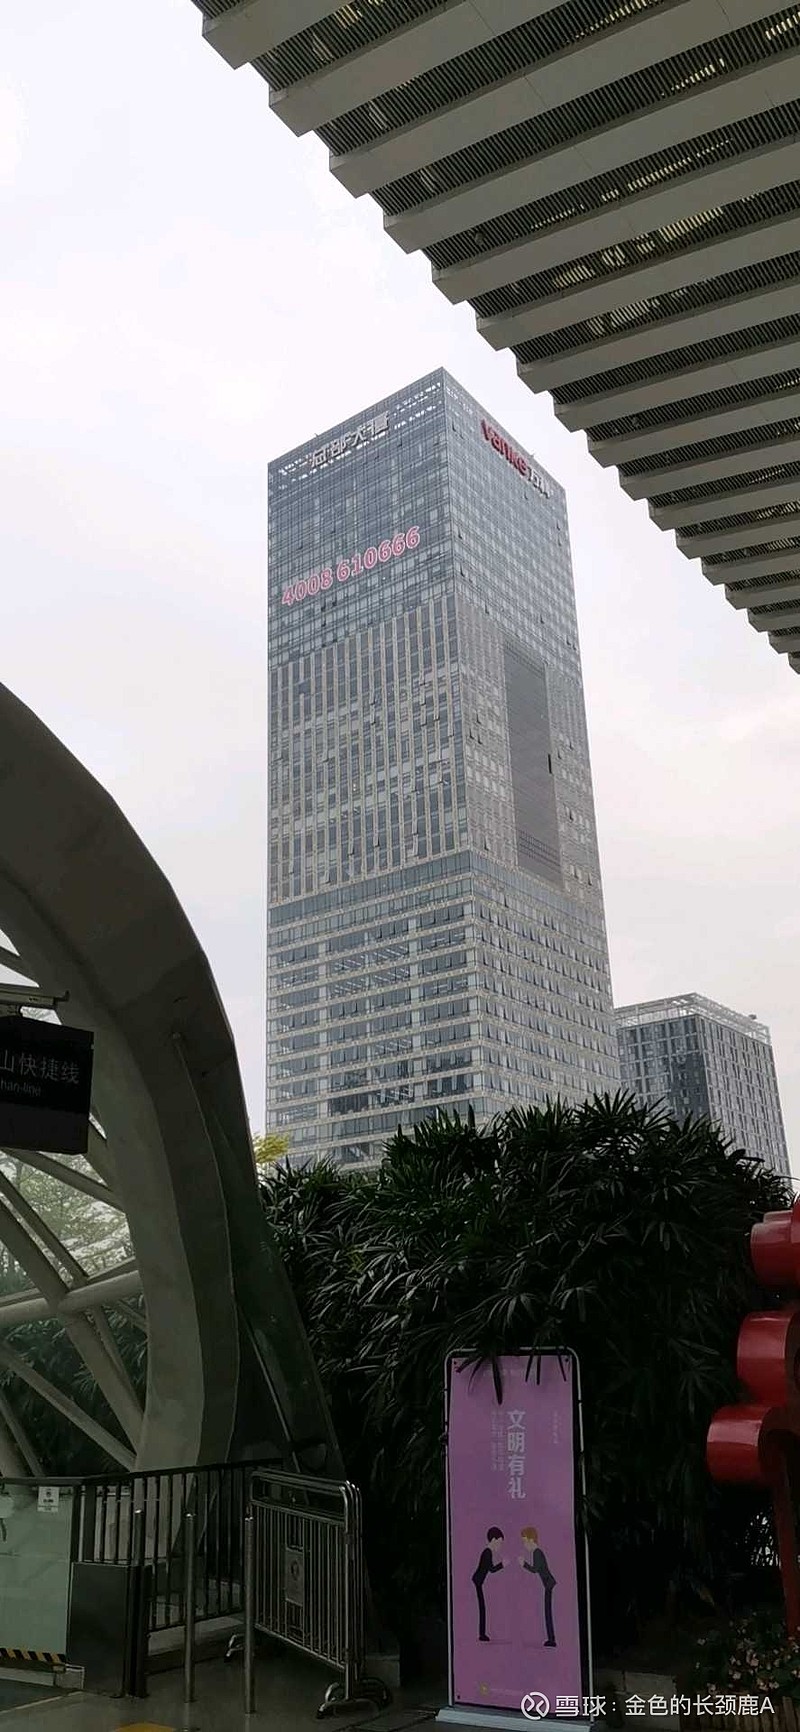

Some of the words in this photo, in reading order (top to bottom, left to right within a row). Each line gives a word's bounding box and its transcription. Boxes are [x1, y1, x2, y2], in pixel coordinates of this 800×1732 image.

[281, 567, 333, 606] 4008
[336, 525, 421, 582] 610666
[507, 1409, 526, 1499] 文明有礼
